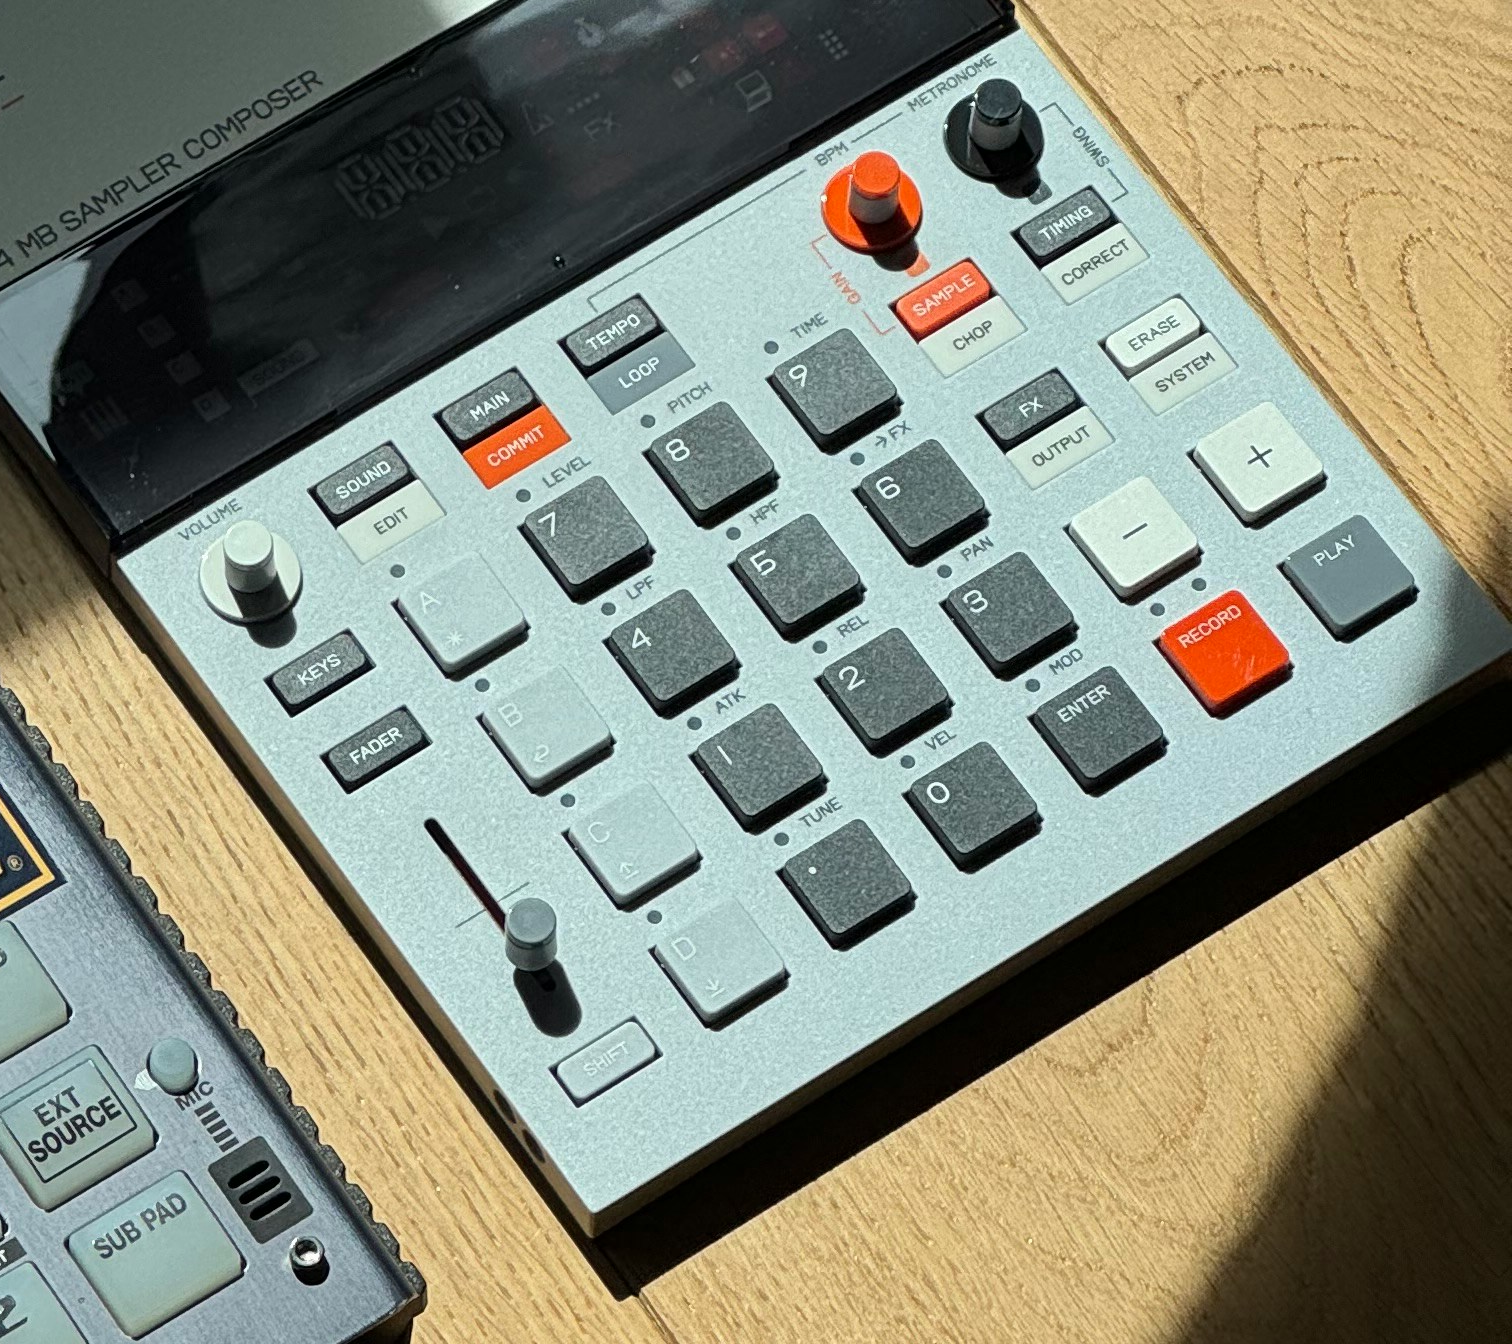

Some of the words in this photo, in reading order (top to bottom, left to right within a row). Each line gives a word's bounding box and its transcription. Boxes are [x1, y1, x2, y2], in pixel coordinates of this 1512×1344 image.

[906, 52, 998, 113] METRONOME
[13, 220, 60, 258] MB
[56, 149, 183, 234] SAMPLER
[178, 66, 325, 162] COMPOSER
[813, 141, 849, 167] BPM
[1070, 124, 1111, 169] SWING
[1038, 203, 1094, 243] TIMING
[1060, 237, 1133, 287] CORRECT
[829, 269, 863, 306] GAIN
[911, 272, 977, 318] SAMPLE
[585, 311, 643, 352] TEMPO
[789, 311, 829, 340] TIME
[950, 319, 997, 353] CHOP
[1127, 313, 1182, 353] ERASE
[617, 355, 664, 390] LOOP
[1153, 350, 1216, 394] SYSTEM
[468, 390, 511, 421] MAIN
[666, 380, 713, 414] PITCH
[1018, 396, 1045, 419] FX
[485, 424, 548, 468] COMMIT
[665, 436, 691, 463] 8
[1030, 424, 1093, 468] OUTPUT
[334, 459, 393, 500] SOUND
[541, 453, 592, 489] LEVEL
[176, 497, 243, 543] VOLUME
[372, 506, 412, 536] EDIT
[751, 550, 777, 576] 5
[960, 535, 995, 562] PAN
[1312, 533, 1358, 567] PLAY
[1177, 603, 1243, 650] RECORD
[296, 652, 343, 686] KEYS
[1048, 647, 1086, 676] MOD
[1056, 683, 1112, 724] ENTER
[348, 725, 404, 765] FADER
[799, 796, 844, 830] TUNE
[582, 1040, 632, 1078] SHIFT
[32, 1085, 85, 1128] EXT
[25, 1095, 123, 1165] SOURCE
[90, 1218, 144, 1261] SUB
[138, 1190, 190, 1232] PAD
